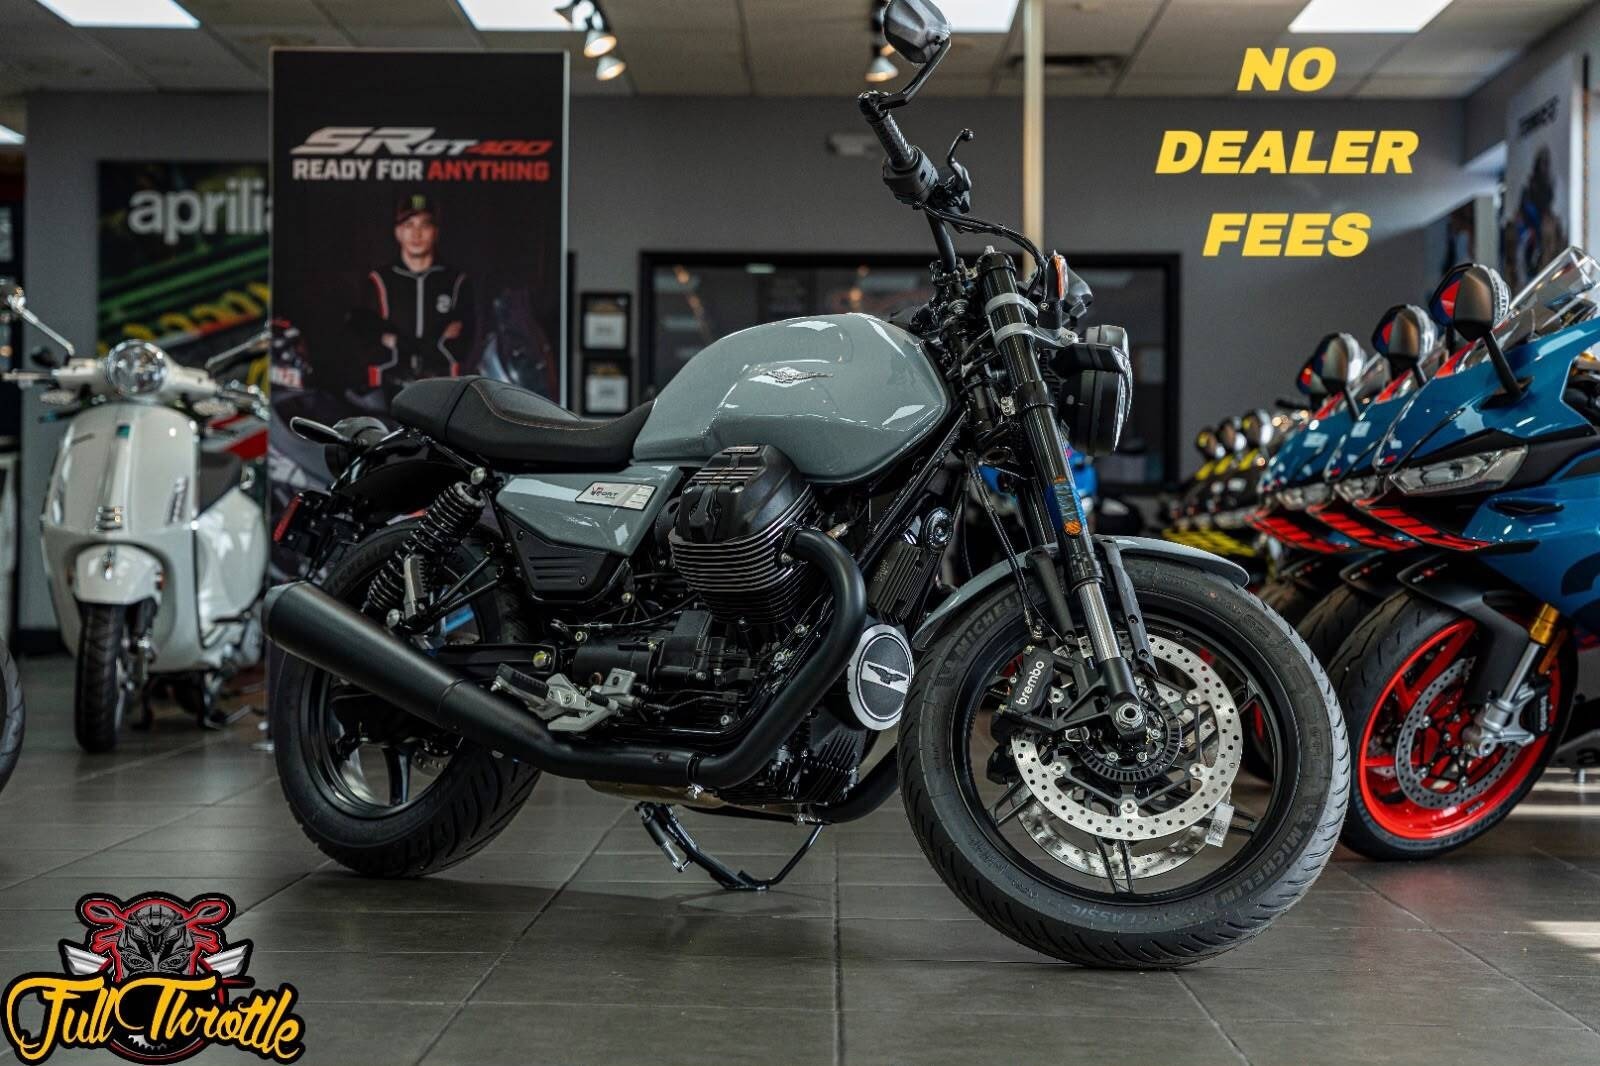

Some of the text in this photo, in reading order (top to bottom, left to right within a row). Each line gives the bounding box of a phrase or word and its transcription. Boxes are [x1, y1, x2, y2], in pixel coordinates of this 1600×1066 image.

[292, 158, 550, 182] READY FOR ANYTHING
[128, 177, 272, 246] aprili
[1016, 660, 1045, 705] brembo
[1219, 824, 1306, 904] MICHELIN
